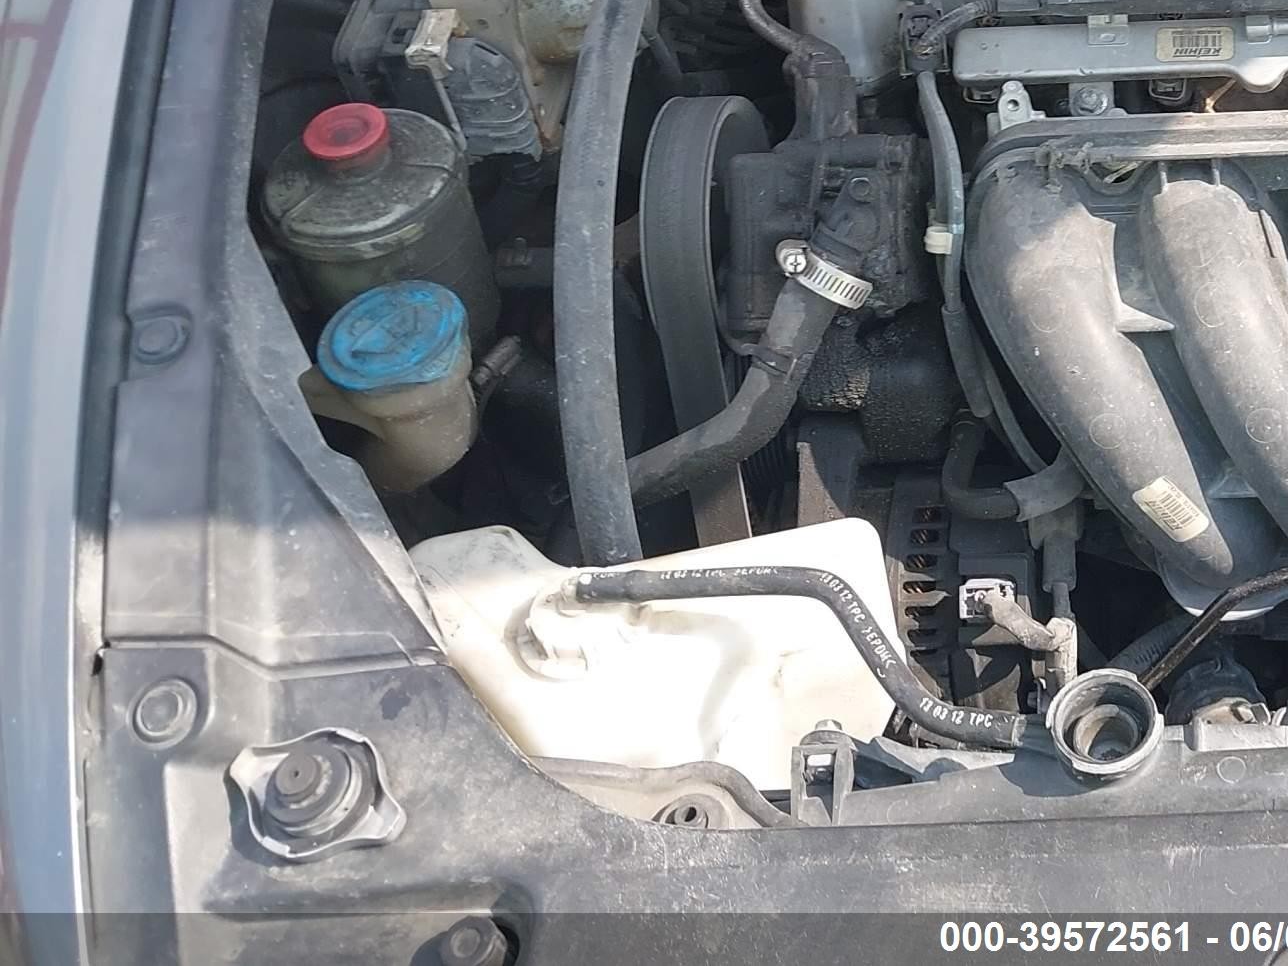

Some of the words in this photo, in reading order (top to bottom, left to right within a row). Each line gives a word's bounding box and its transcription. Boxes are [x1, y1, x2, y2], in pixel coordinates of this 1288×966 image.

[1174, 47, 1222, 58] KEIHIN
[846, 599, 866, 623] TPC
[969, 712, 995, 728] TPC
